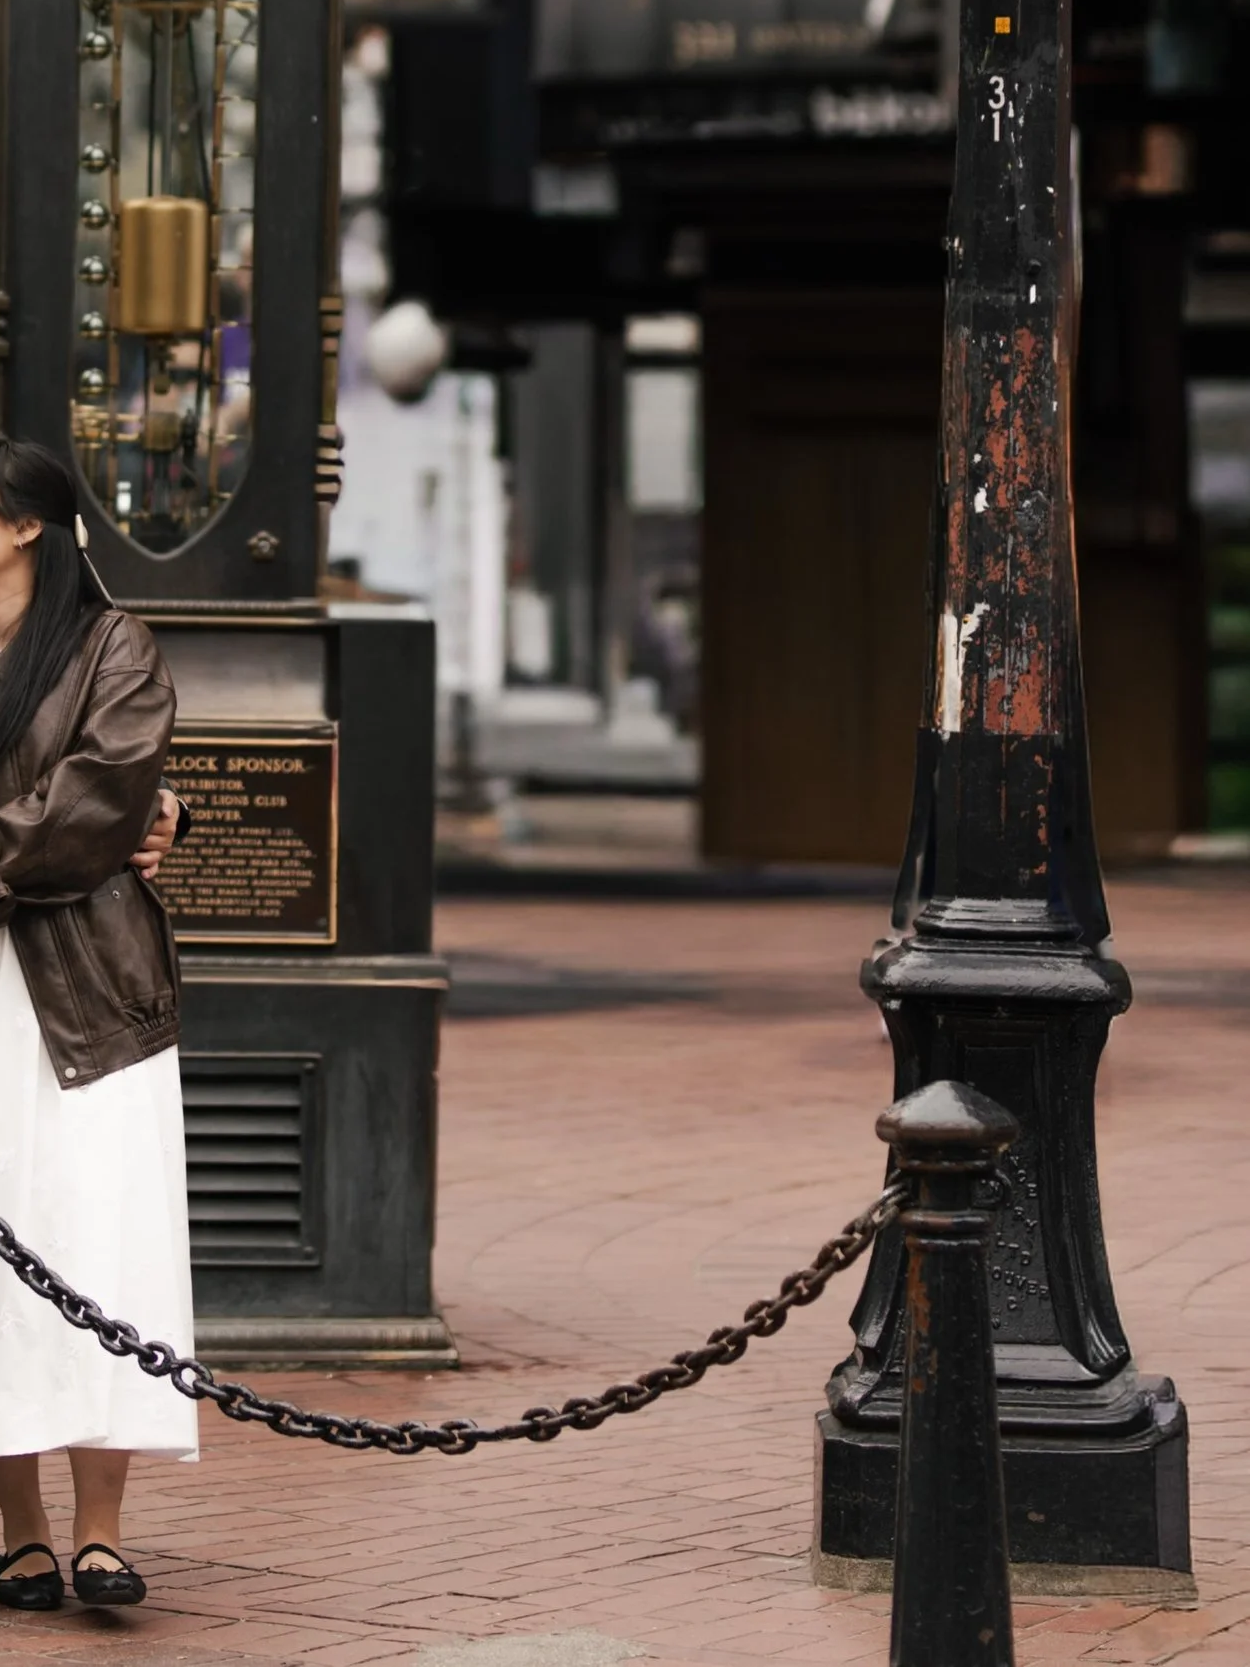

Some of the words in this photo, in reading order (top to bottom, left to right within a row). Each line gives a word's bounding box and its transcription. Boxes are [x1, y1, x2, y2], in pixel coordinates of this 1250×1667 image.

[163, 755, 218, 772] CLOCK
[226, 756, 306, 774] SPONSOR
[170, 778, 245, 791] NTRIBUTOR
[211, 794, 249, 807] LIONS
[254, 795, 288, 809] CLUB
[191, 809, 243, 822] COUVER
[993, 1265, 1049, 1300] OUVER
